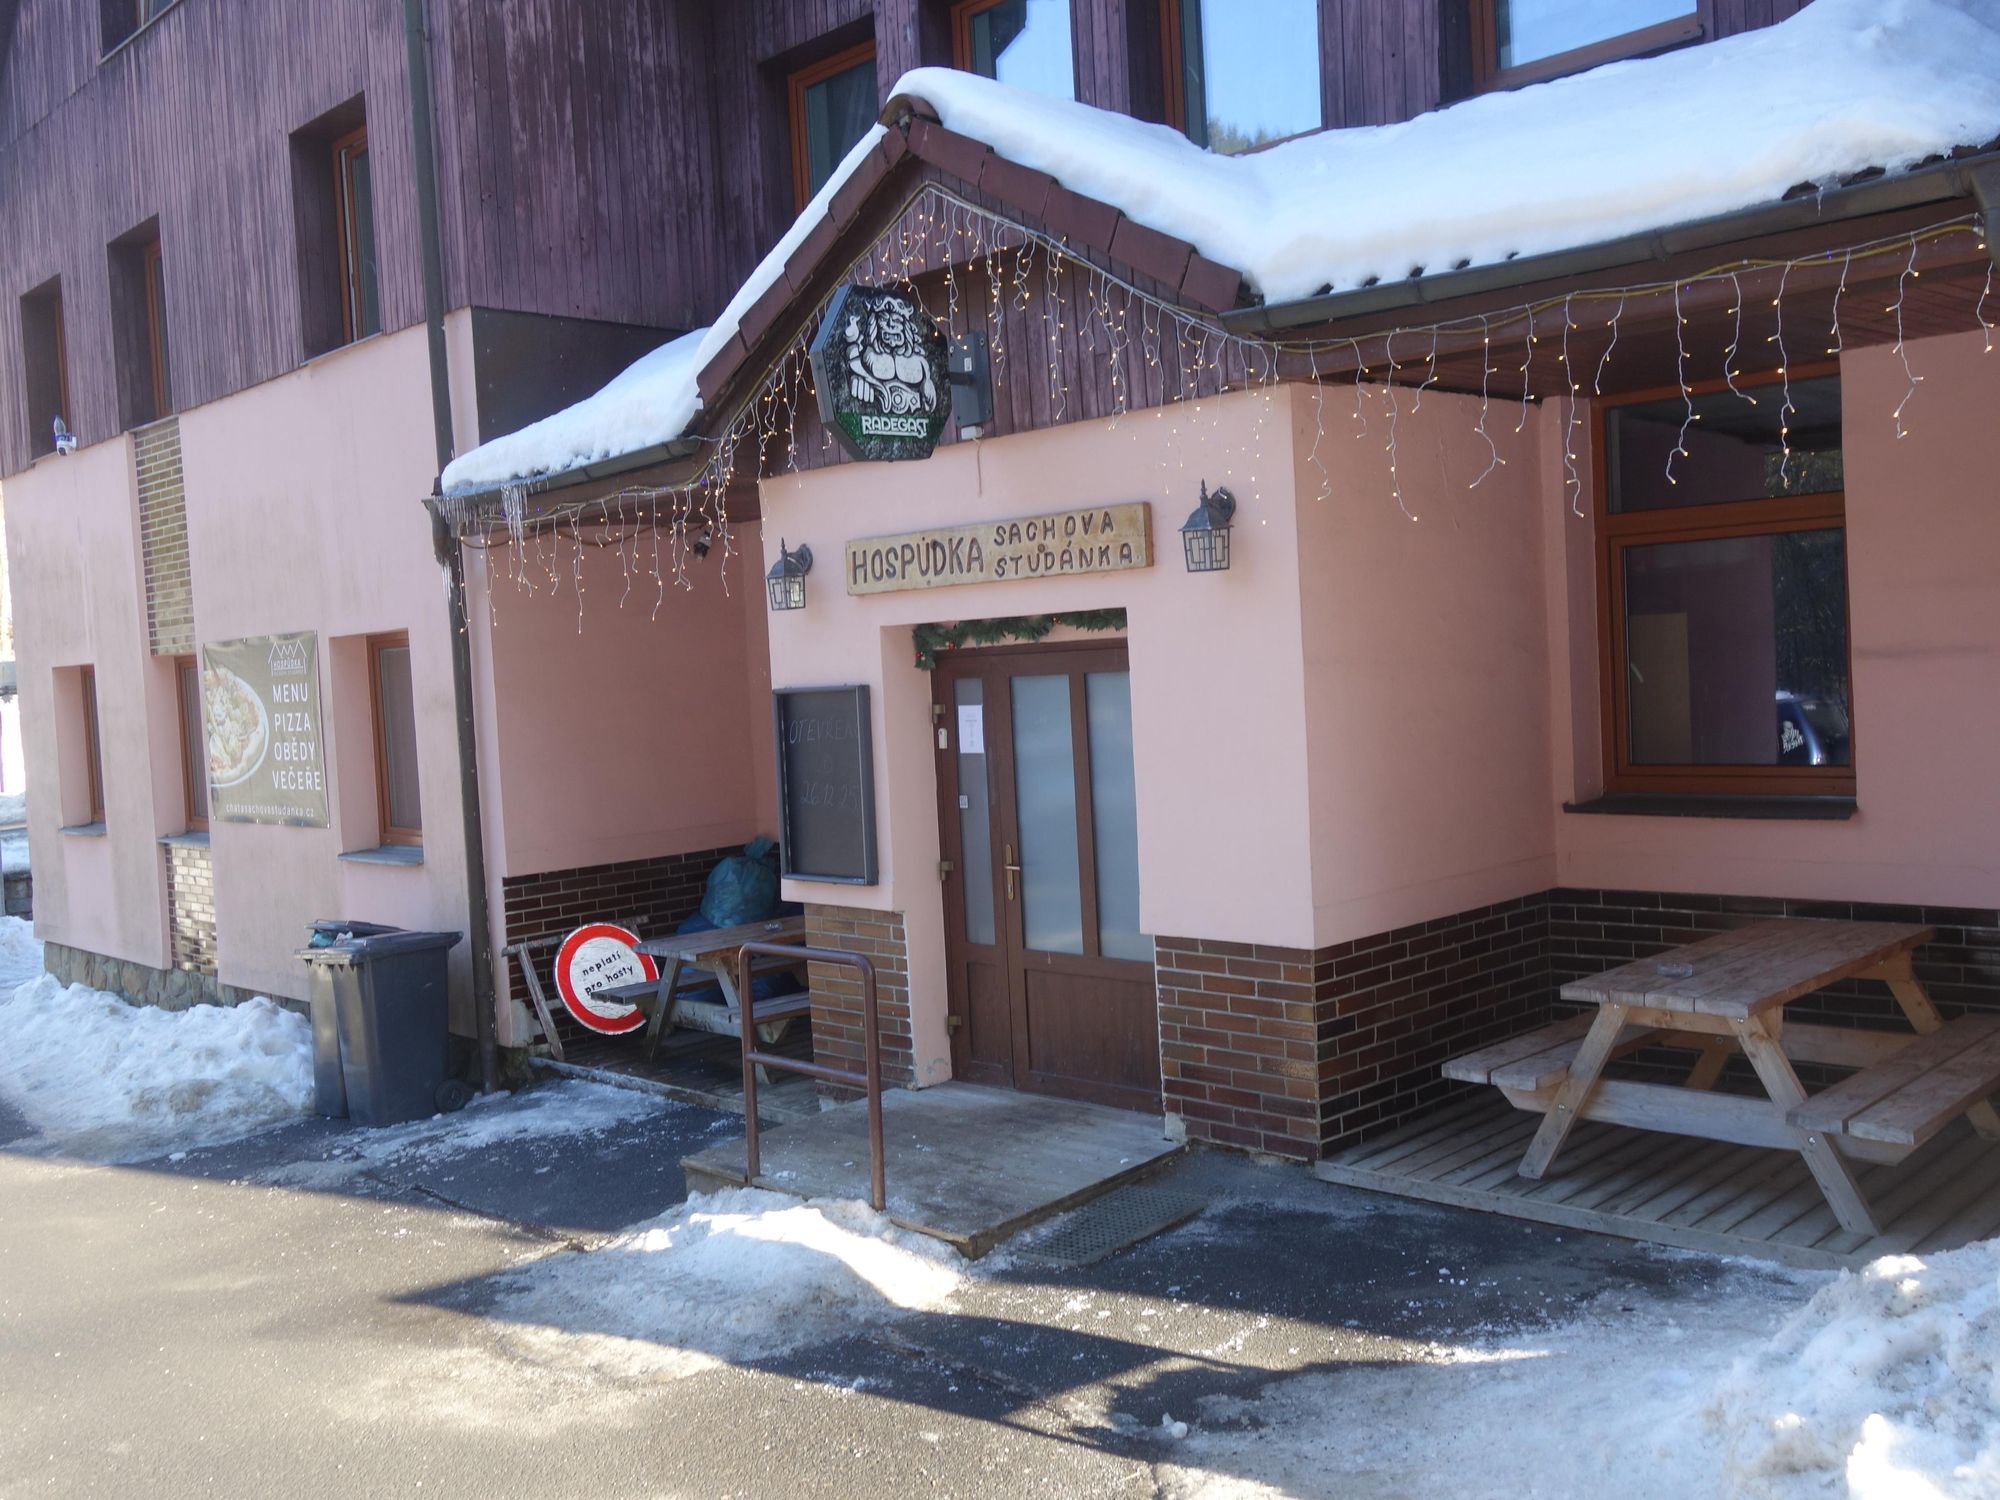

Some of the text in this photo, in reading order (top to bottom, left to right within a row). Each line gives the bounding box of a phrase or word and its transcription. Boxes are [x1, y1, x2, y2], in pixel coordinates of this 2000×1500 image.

[861, 415, 929, 438] RADEGAST
[994, 511, 1114, 546] SACHOVA
[272, 683, 308, 703] MENU
[274, 714, 311, 731] PIZZA
[274, 738, 316, 761] OBĚDY
[272, 767, 321, 791] VEČEŘE
[582, 950, 621, 976] neplatí
[585, 981, 603, 996] pro
